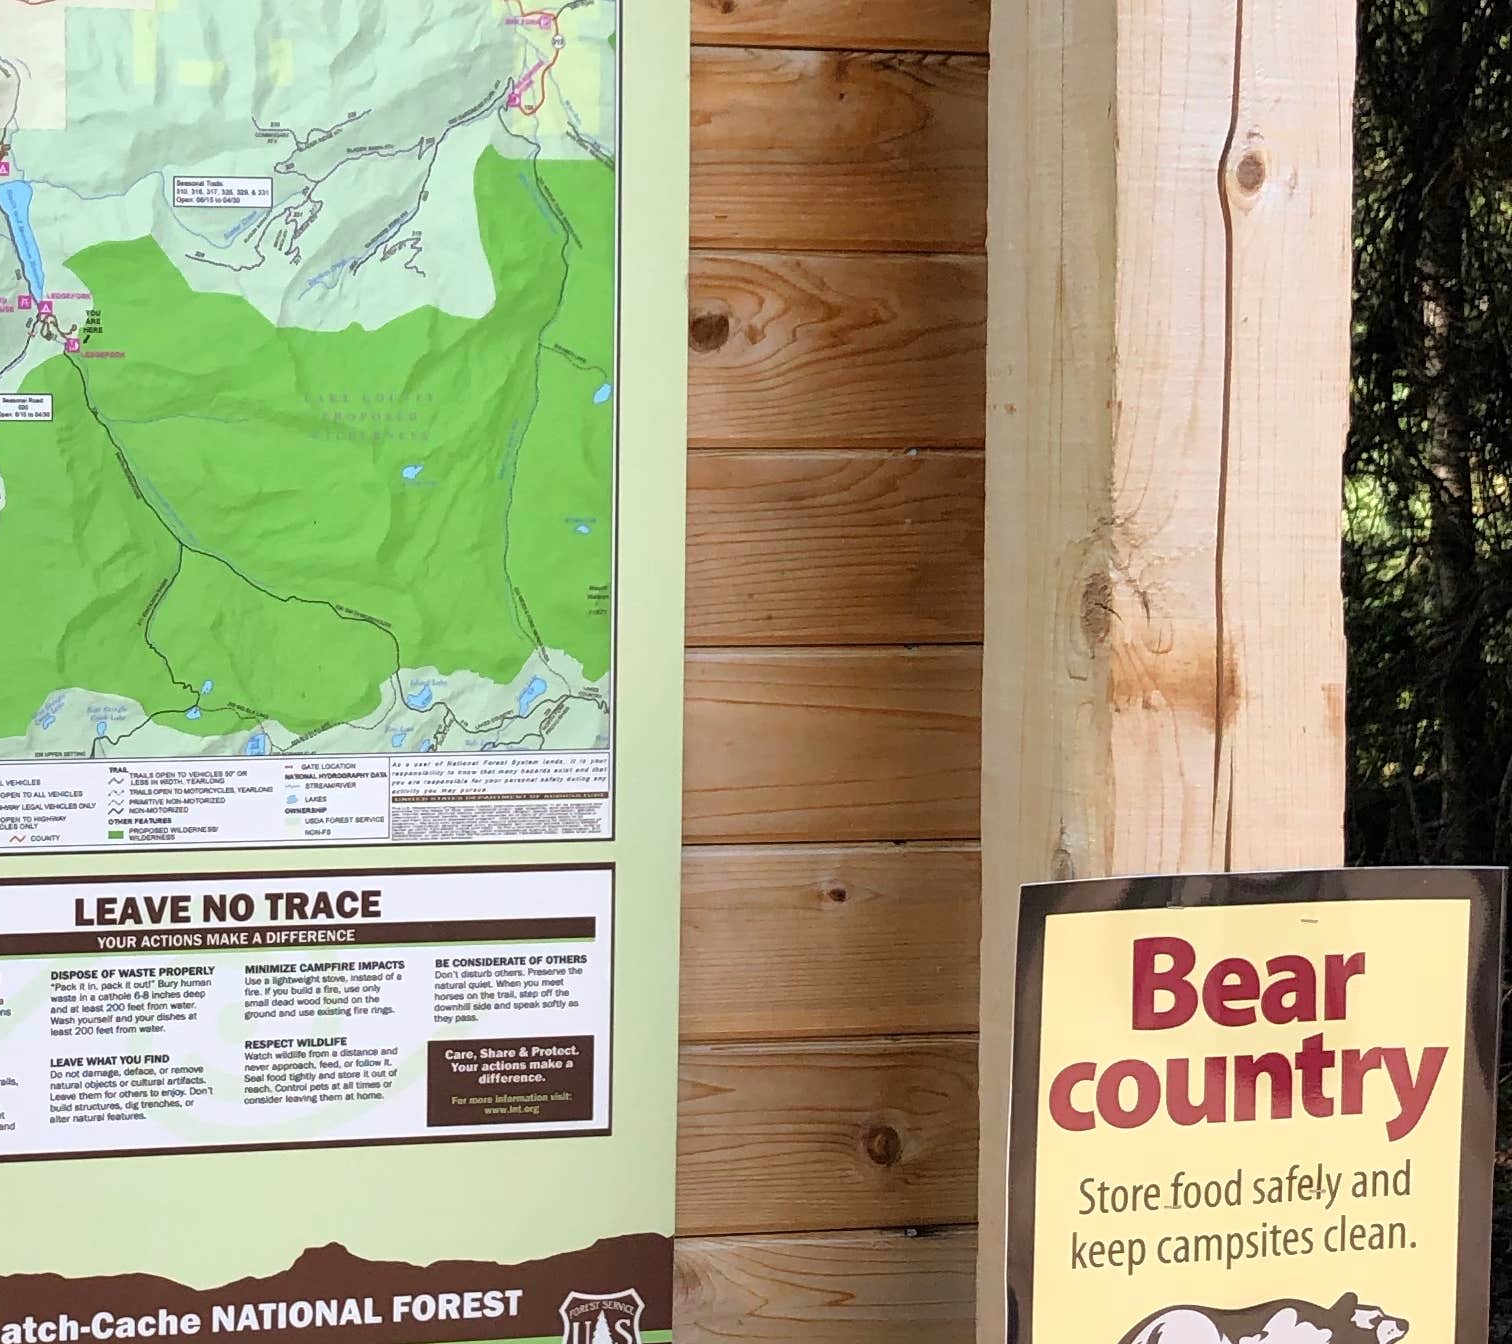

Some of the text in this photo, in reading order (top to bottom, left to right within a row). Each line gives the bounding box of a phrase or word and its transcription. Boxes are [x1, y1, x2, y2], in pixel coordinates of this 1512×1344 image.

[85, 308, 102, 317] YOU
[85, 317, 101, 325] ARE
[4, 778, 41, 786] VEHICLES
[29, 834, 60, 842] COUNTY
[74, 889, 381, 926] LEAVE NO TRACE
[96, 928, 355, 949] YOUR ACTIONS MAKE A DIFFERENCE
[244, 959, 405, 974] MINIMIZE CAMPFIRE IMPACTS
[434, 954, 588, 968] BE CONSIDERATE OF OTHERS
[50, 965, 215, 980] DISPOSE OF WASTE PROPERLY
[1131, 937, 1365, 1029] Bear
[244, 1036, 347, 1049] RESPECT WILDLIFE
[49, 1053, 170, 1067] LEAVE WHAT YOU FIND
[444, 1045, 580, 1060] Care, Share & Protect.
[450, 1058, 573, 1072] Your actions make a
[477, 1072, 546, 1084] difference.
[1049, 1032, 1448, 1142] country
[1078, 1158, 1411, 1214] Store food safely and
[1071, 1217, 1416, 1275] keep campsites clean.
[211, 1298, 382, 1331] NATIONAL
[392, 1289, 523, 1321] FOREST
[569, 1301, 635, 1319] FOREST SERVICE
